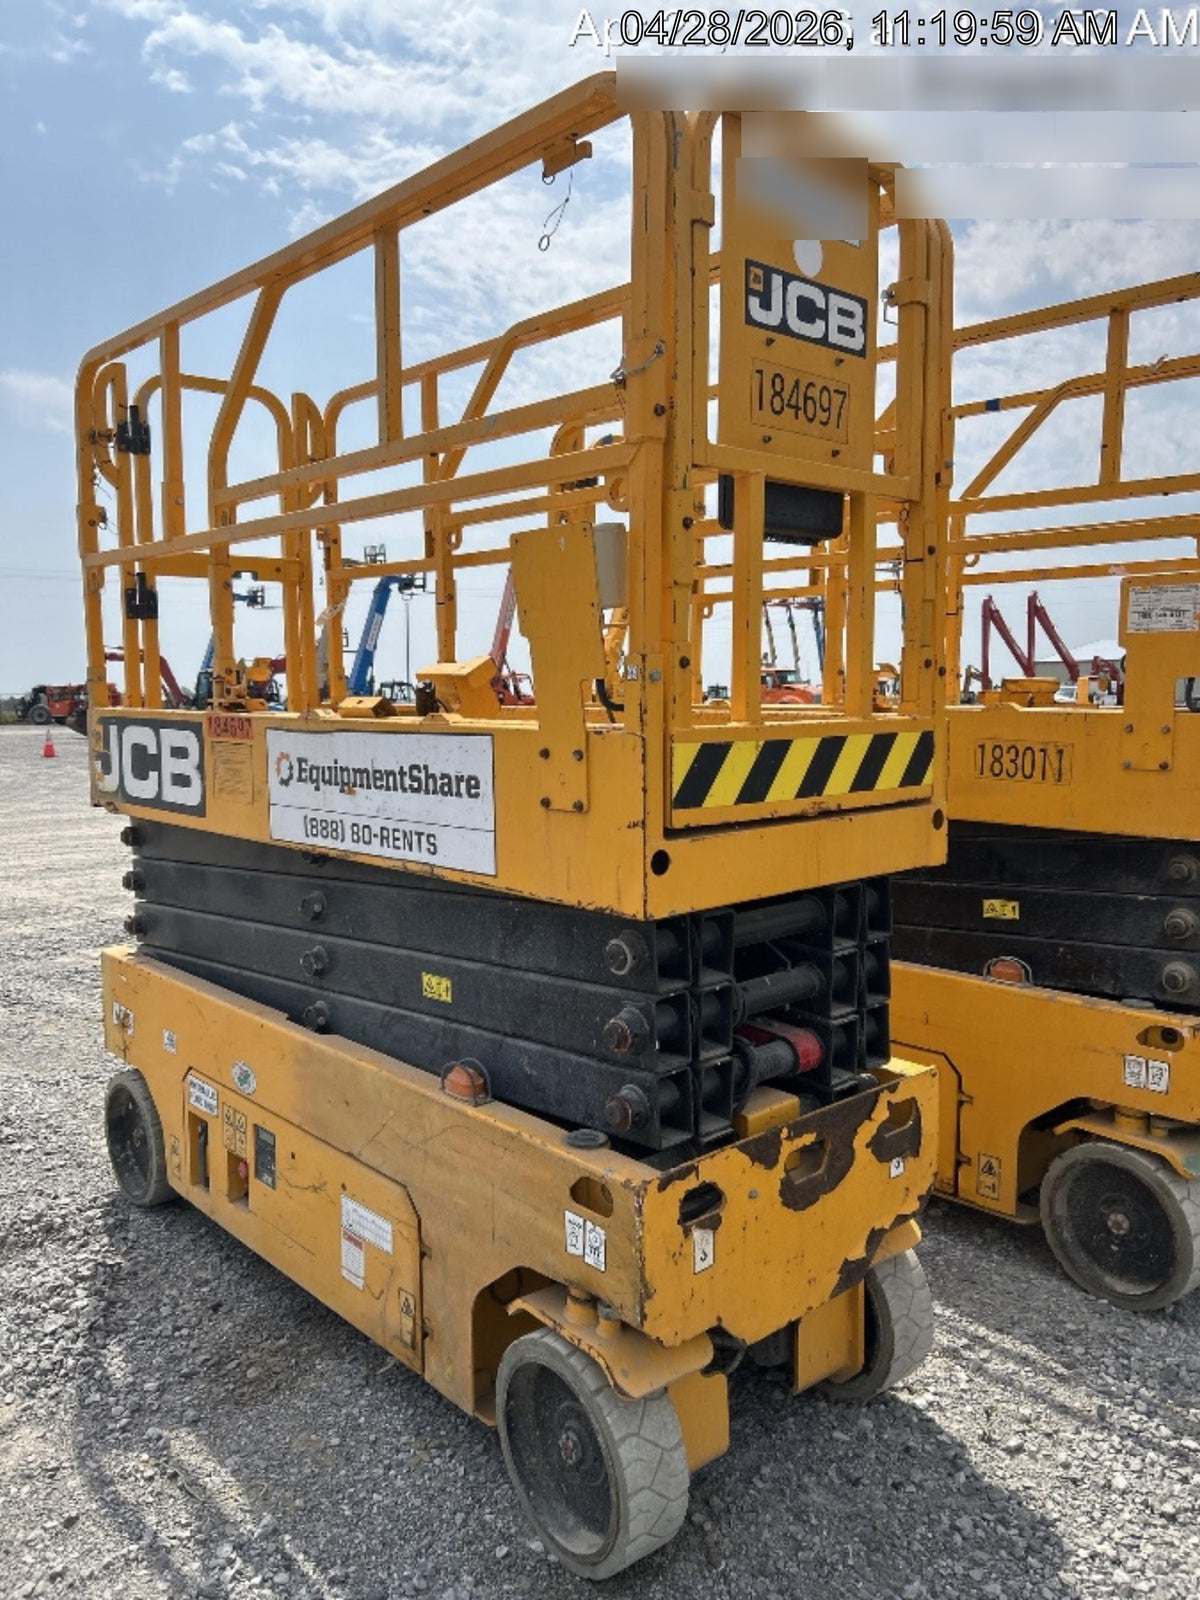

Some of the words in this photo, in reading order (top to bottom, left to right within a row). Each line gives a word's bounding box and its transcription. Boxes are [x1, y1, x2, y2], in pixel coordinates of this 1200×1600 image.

[747, 273, 865, 352] JCB
[754, 368, 848, 430] 184697
[206, 714, 253, 741] 184697
[94, 724, 203, 807] JCB
[296, 756, 481, 800] EquipmentShare
[303, 813, 346, 844] (888)
